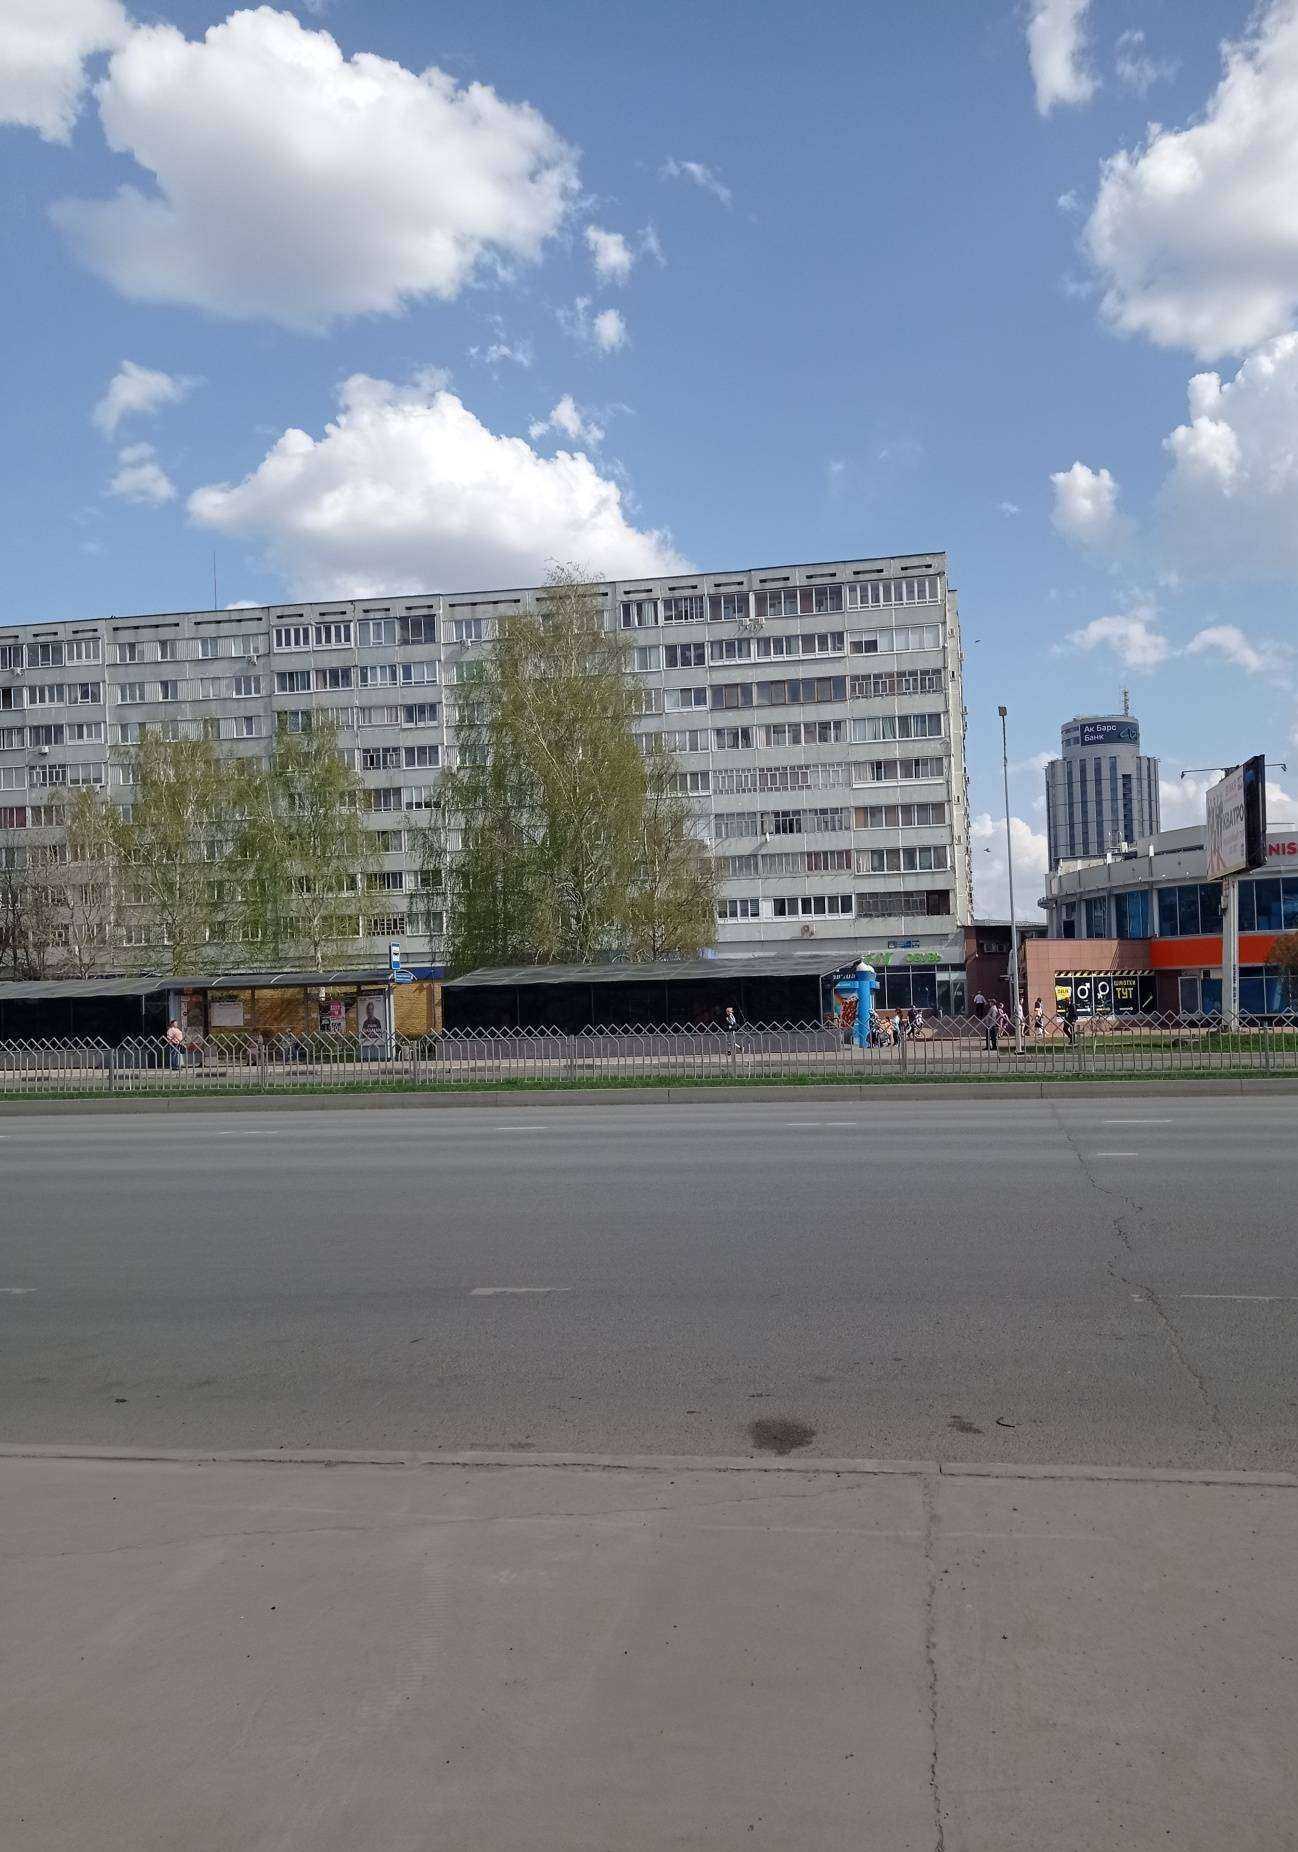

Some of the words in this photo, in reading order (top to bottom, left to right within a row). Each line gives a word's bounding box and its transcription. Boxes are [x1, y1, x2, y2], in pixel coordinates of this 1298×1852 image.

[1084, 725, 1095, 733] Ак
[1096, 724, 1117, 733] Барс
[1084, 734, 1104, 742] Банк
[1268, 841, 1297, 857] NIS
[1115, 987, 1134, 999] ТУТ
